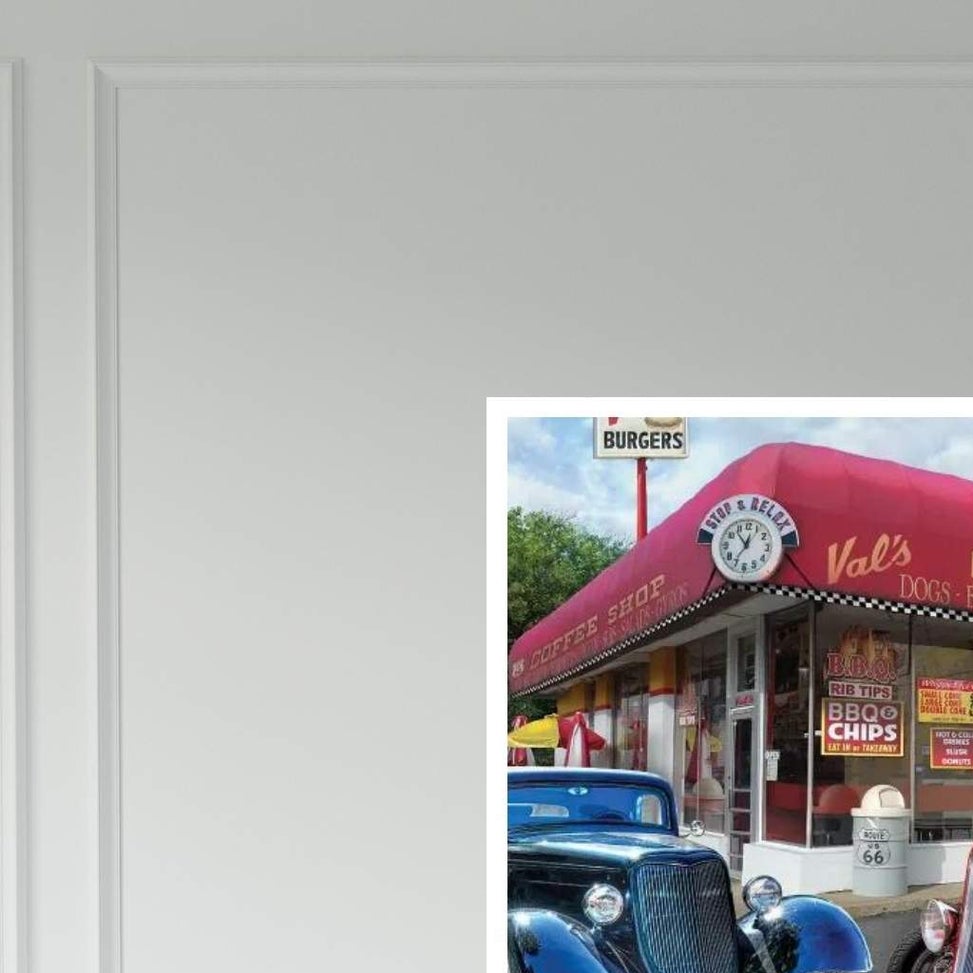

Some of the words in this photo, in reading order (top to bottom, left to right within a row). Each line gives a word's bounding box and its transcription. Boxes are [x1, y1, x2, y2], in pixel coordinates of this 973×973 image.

[603, 430, 684, 449] BURGERS
[705, 502, 732, 530] STOP
[750, 496, 791, 533] RELAX
[827, 533, 912, 585] Val's
[900, 573, 951, 605] DOGS
[529, 616, 599, 671] COFFEE
[607, 574, 666, 625] SHOP
[830, 682, 855, 696] RIB
[859, 685, 891, 699] TIPS
[828, 703, 878, 724] BBQ
[828, 722, 898, 742] CHIPS
[827, 742, 841, 752] EAT
[862, 849, 884, 865] 66
